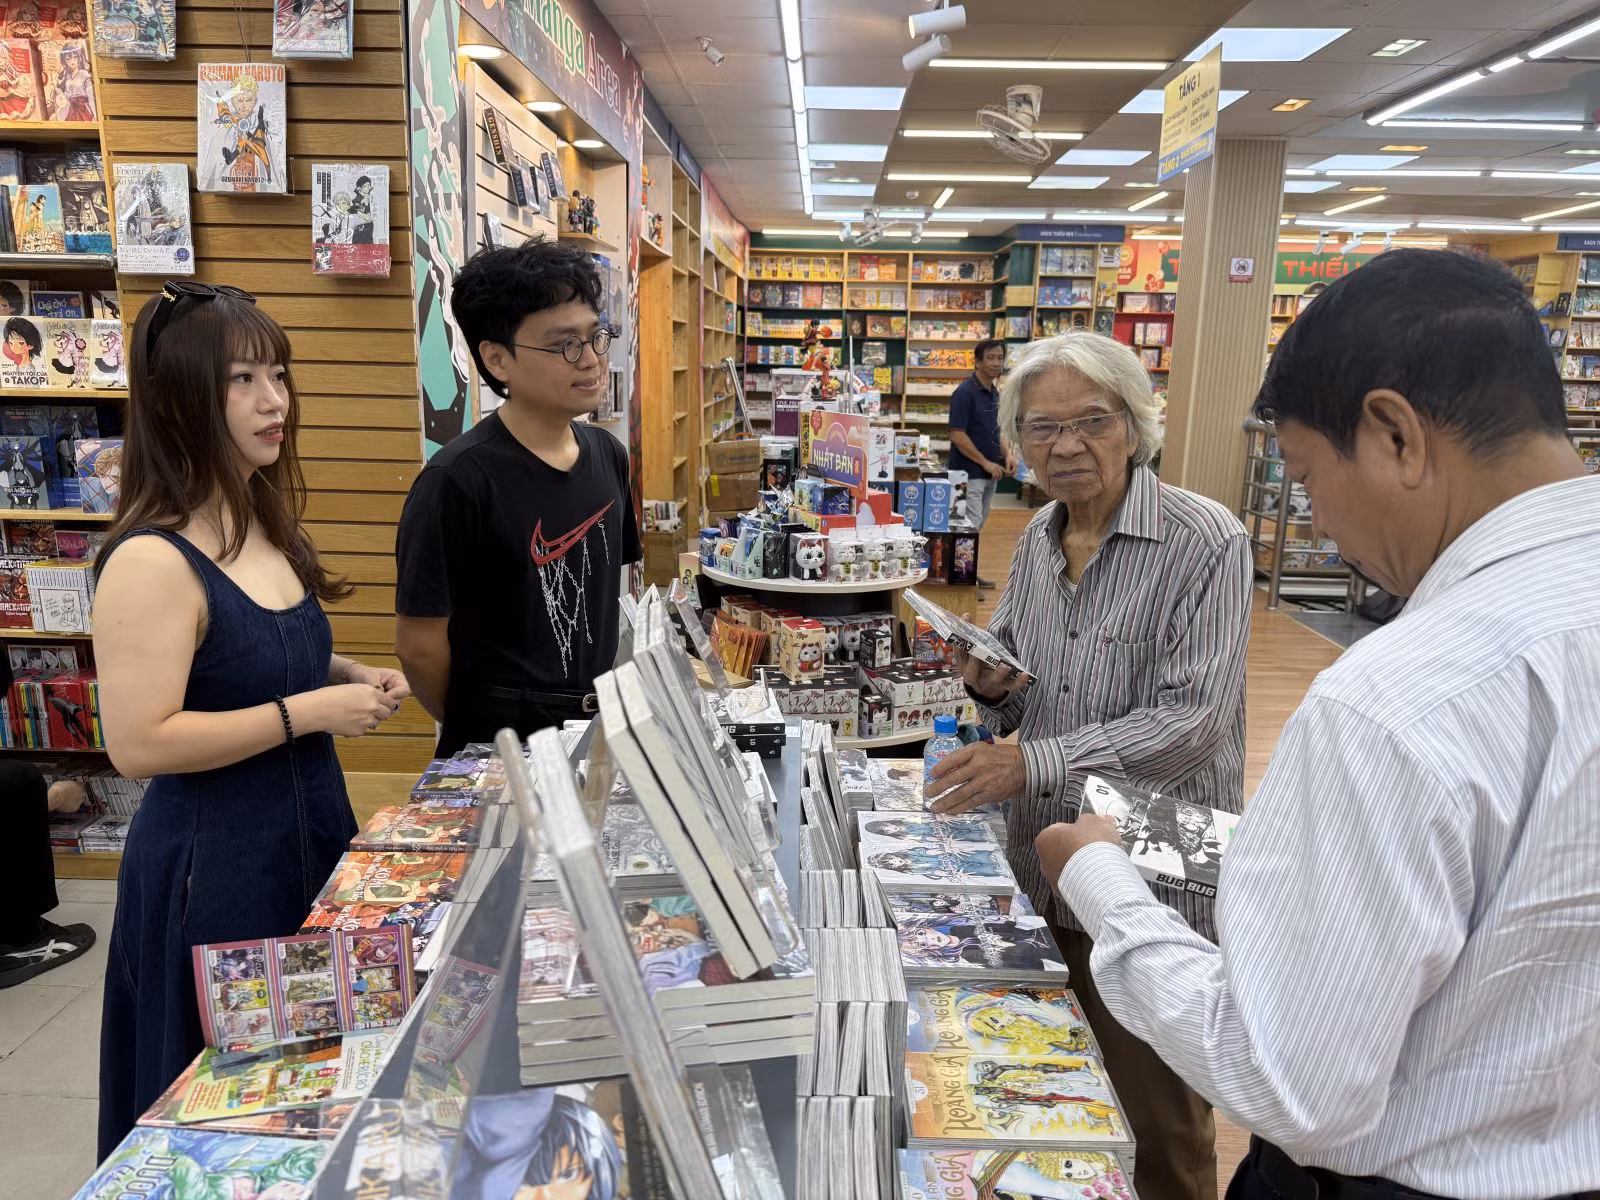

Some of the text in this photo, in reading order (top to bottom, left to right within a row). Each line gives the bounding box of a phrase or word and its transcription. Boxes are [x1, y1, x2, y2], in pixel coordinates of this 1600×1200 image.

[813, 447, 853, 475] NHẬT BẢN
[1156, 873, 1216, 897] BUG BUG
